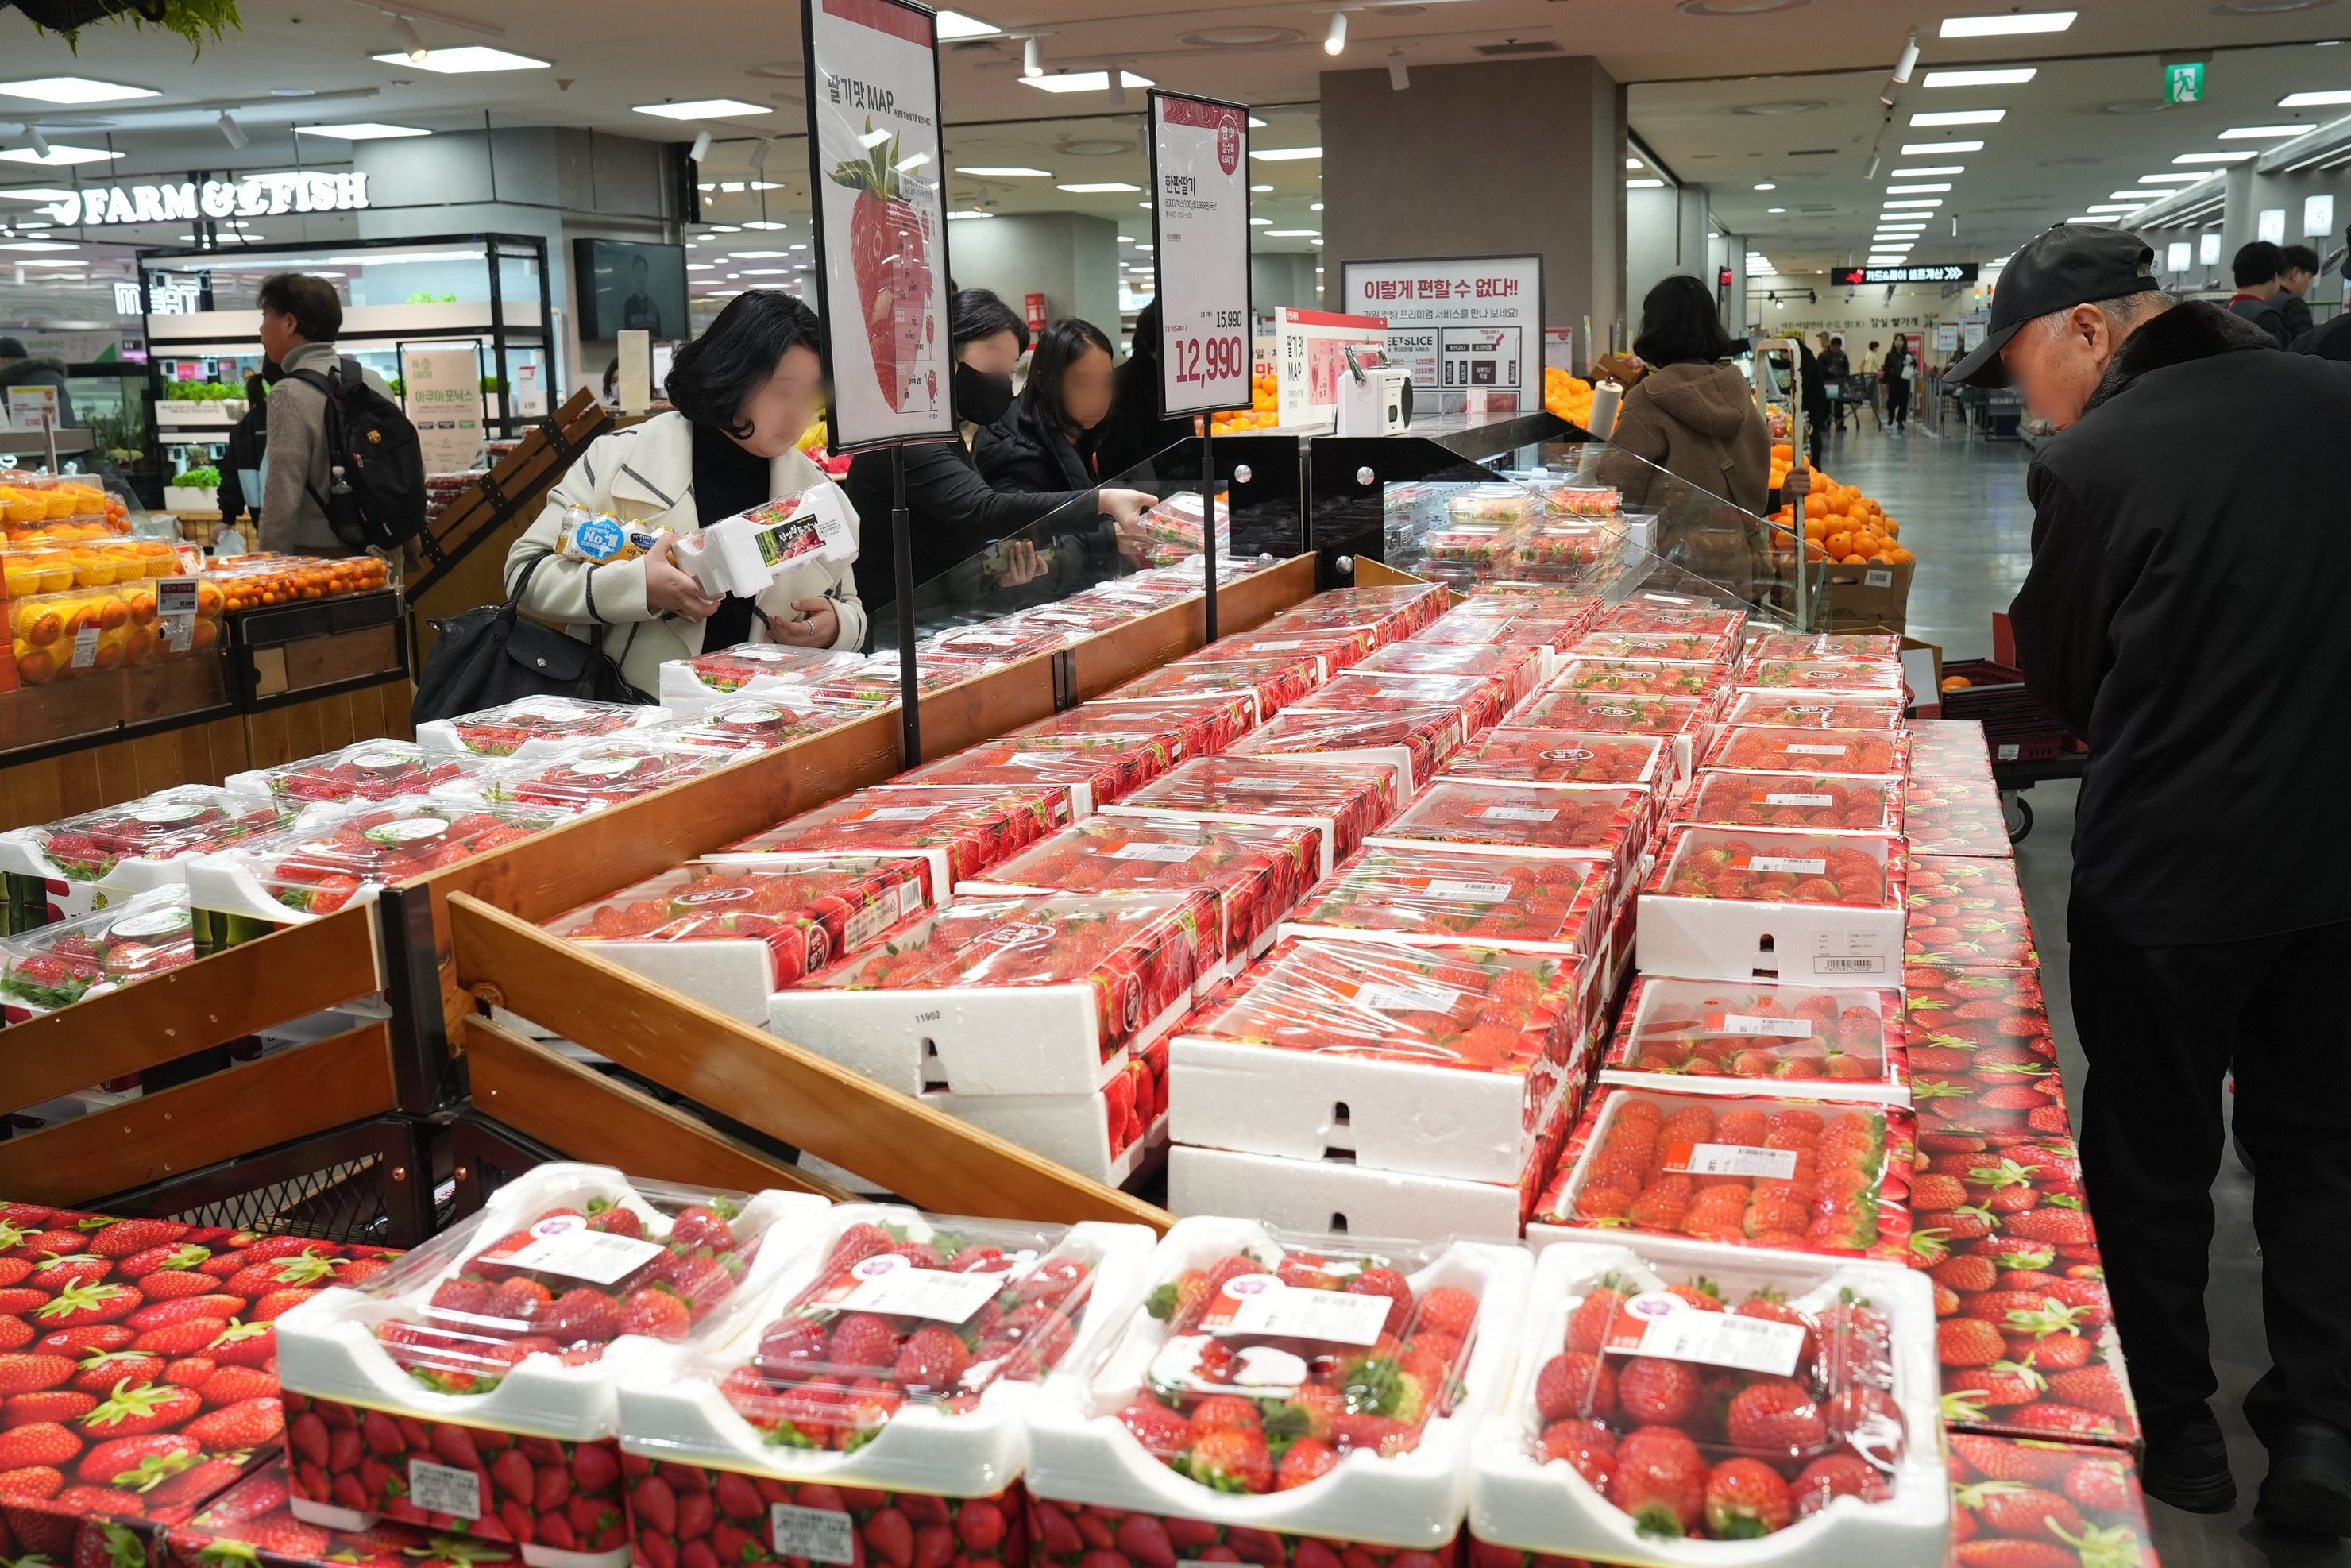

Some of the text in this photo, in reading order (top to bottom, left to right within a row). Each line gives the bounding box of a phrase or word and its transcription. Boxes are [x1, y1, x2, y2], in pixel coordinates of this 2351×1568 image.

[867, 84, 894, 114] MAP
[1165, 174, 1196, 196] 한판딸기
[82, 172, 370, 225] FARM & FISH
[2317, 211, 2325, 223] 6
[1365, 278, 1519, 300] 이렇게 편할 수 없다!!
[1216, 311, 1242, 330] 15,990
[1400, 309, 1434, 319] 프리미엄
[1435, 309, 1469, 319] 서비스를
[1470, 308, 1488, 319] 만나
[1490, 308, 1519, 319] 보세요!
[1870, 318, 1888, 328] 잠실
[1176, 336, 1242, 388] 12,990
[1288, 361, 1302, 382] MAP
[415, 388, 474, 403] 아쿠아포닉스
[583, 530, 619, 548] No.1
[915, 1010, 941, 1024] 11902
